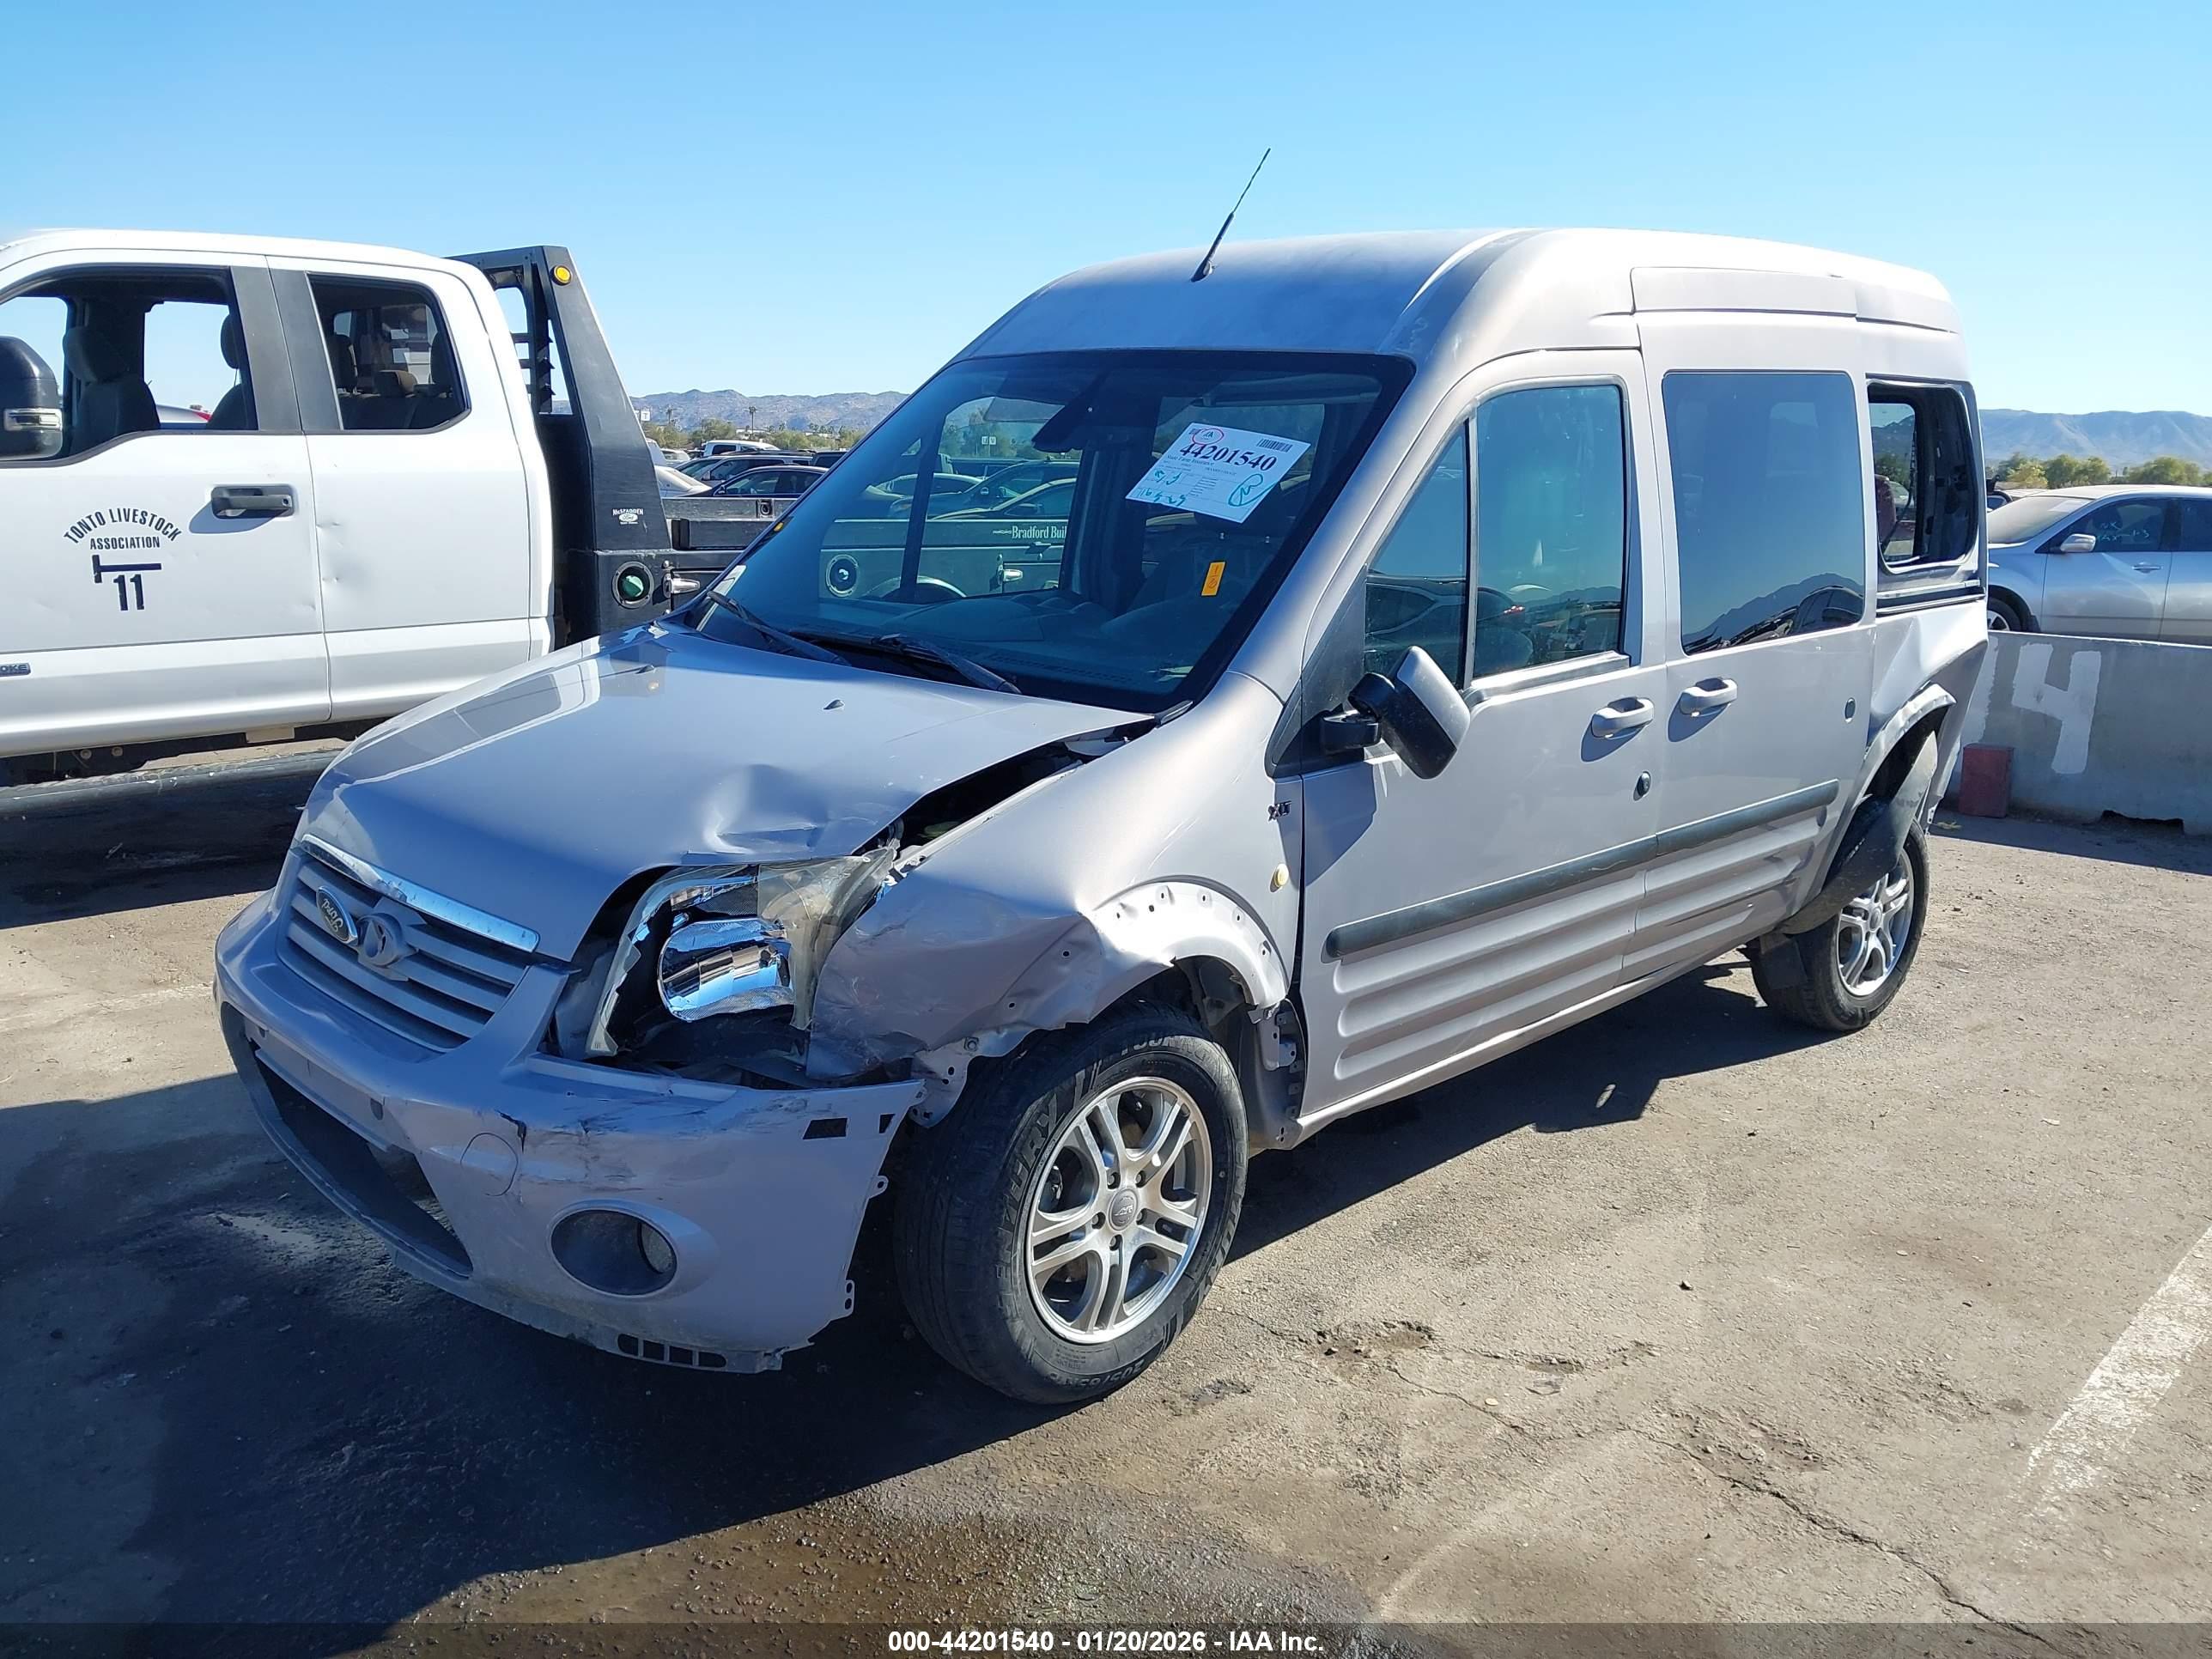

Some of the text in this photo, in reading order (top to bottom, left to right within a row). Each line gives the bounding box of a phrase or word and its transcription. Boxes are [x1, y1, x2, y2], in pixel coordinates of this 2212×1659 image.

[1179, 443, 1278, 471] 44201540
[63, 507, 182, 544] TONTO LIVESTOCK
[1012, 526, 1049, 539] Bradford
[89, 536, 161, 550] ASSOCIATION
[112, 574, 145, 611] 11
[1267, 799, 1292, 822] XLT
[321, 898, 344, 933] Ford
